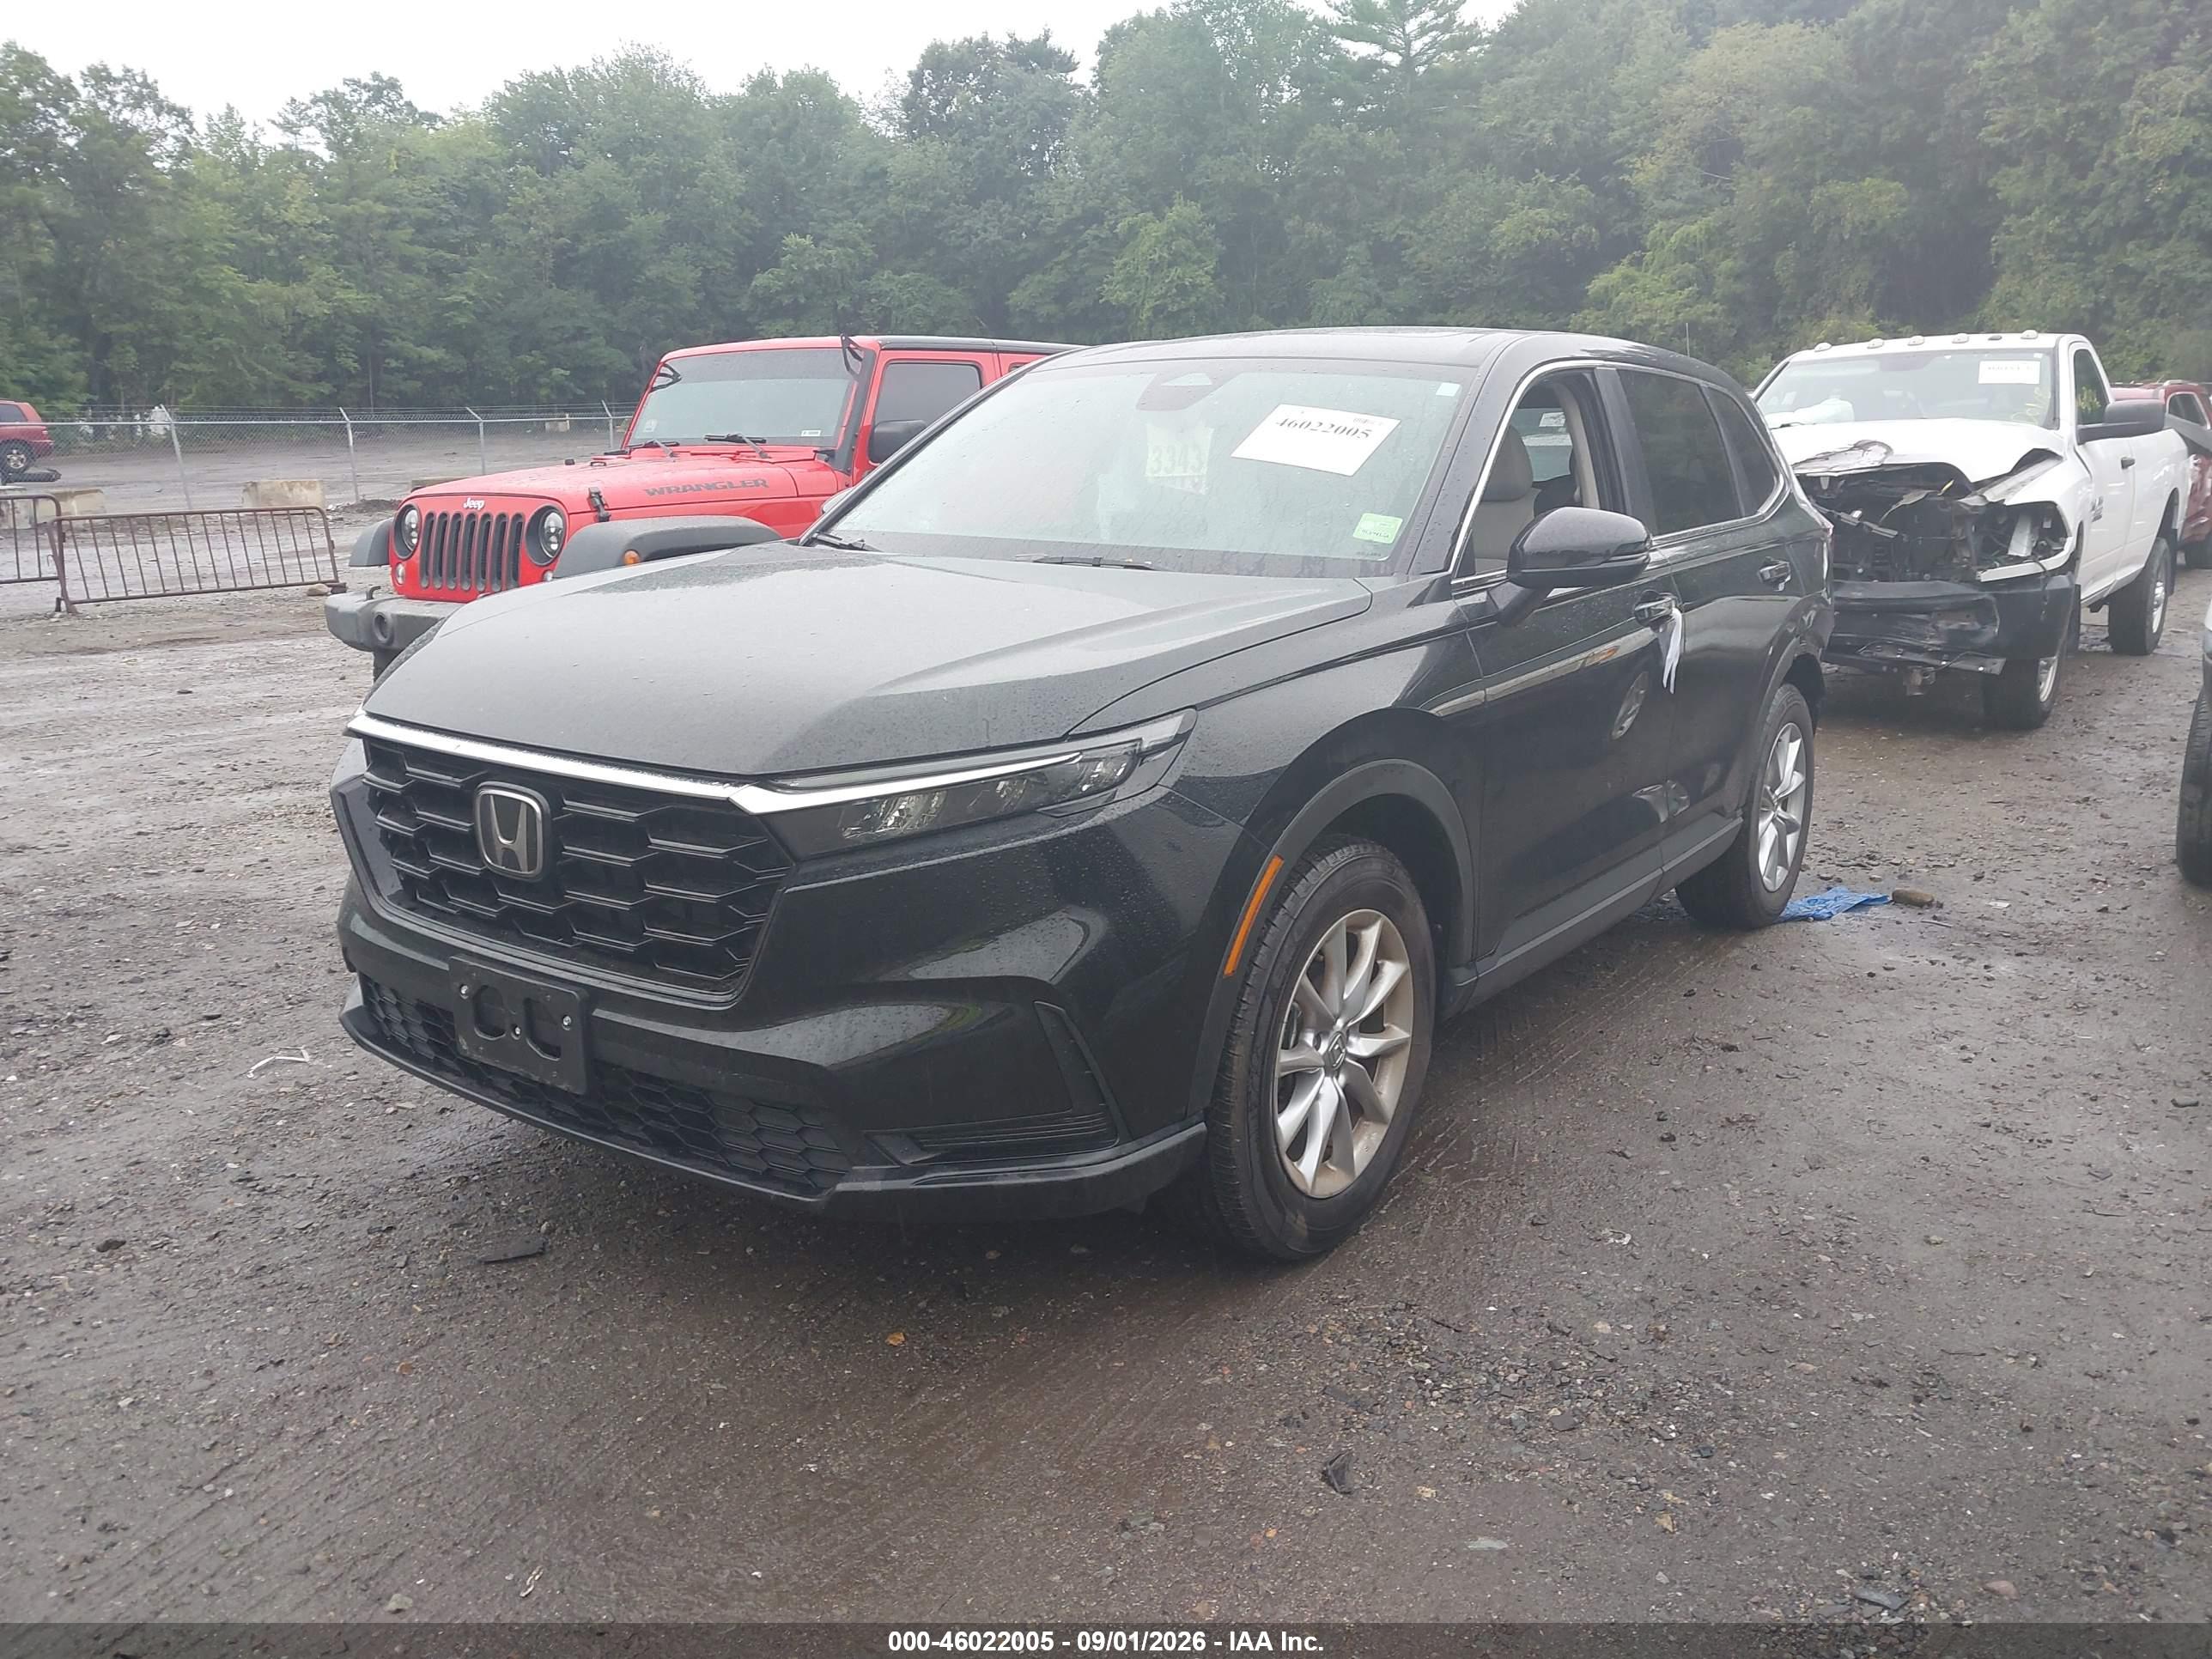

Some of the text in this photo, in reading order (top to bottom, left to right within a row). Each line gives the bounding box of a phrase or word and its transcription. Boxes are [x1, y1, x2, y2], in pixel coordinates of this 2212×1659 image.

[1275, 417, 1373, 439] 46022005
[641, 478, 770, 496] WRANGLER
[463, 496, 485, 511] Jeep
